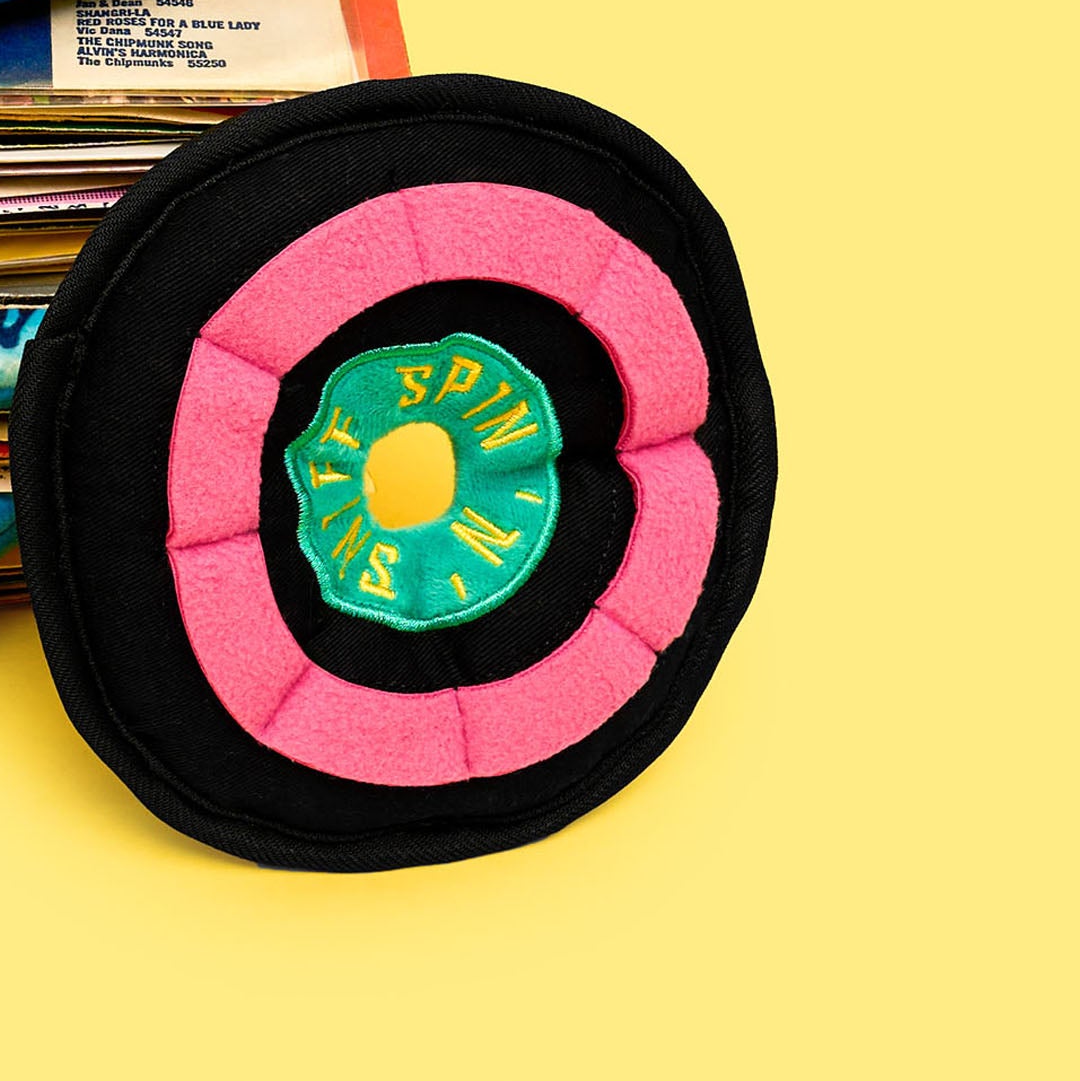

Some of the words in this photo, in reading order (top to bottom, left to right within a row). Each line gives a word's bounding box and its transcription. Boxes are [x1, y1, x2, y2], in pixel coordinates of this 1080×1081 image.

[76, 0, 96, 8] Jan
[99, 0, 109, 8] &
[112, 0, 142, 7] Dean
[76, 8, 152, 18] SHANGRI-LA
[76, 18, 102, 27] RED
[106, 17, 147, 26] ROSES
[150, 18, 175, 28] FOR
[179, 19, 188, 29] A
[192, 20, 225, 30] BLUE
[228, 21, 261, 31] LADY
[76, 26, 96, 35] Vic
[100, 26, 131, 36] Dana
[145, 28, 182, 38] 54547
[77, 37, 103, 46] THE
[106, 37, 174, 49] CHIPMUNK
[178, 40, 214, 50] SONG
[76, 46, 127, 58] ALVIN'S
[130, 48, 208, 59] HARMONICA
[77, 56, 101, 66] The
[105, 57, 174, 69] Chipmunks
[187, 58, 227, 69] 55250
[395, 354, 539, 451] SPIN
[308, 406, 400, 601] SNIFF
